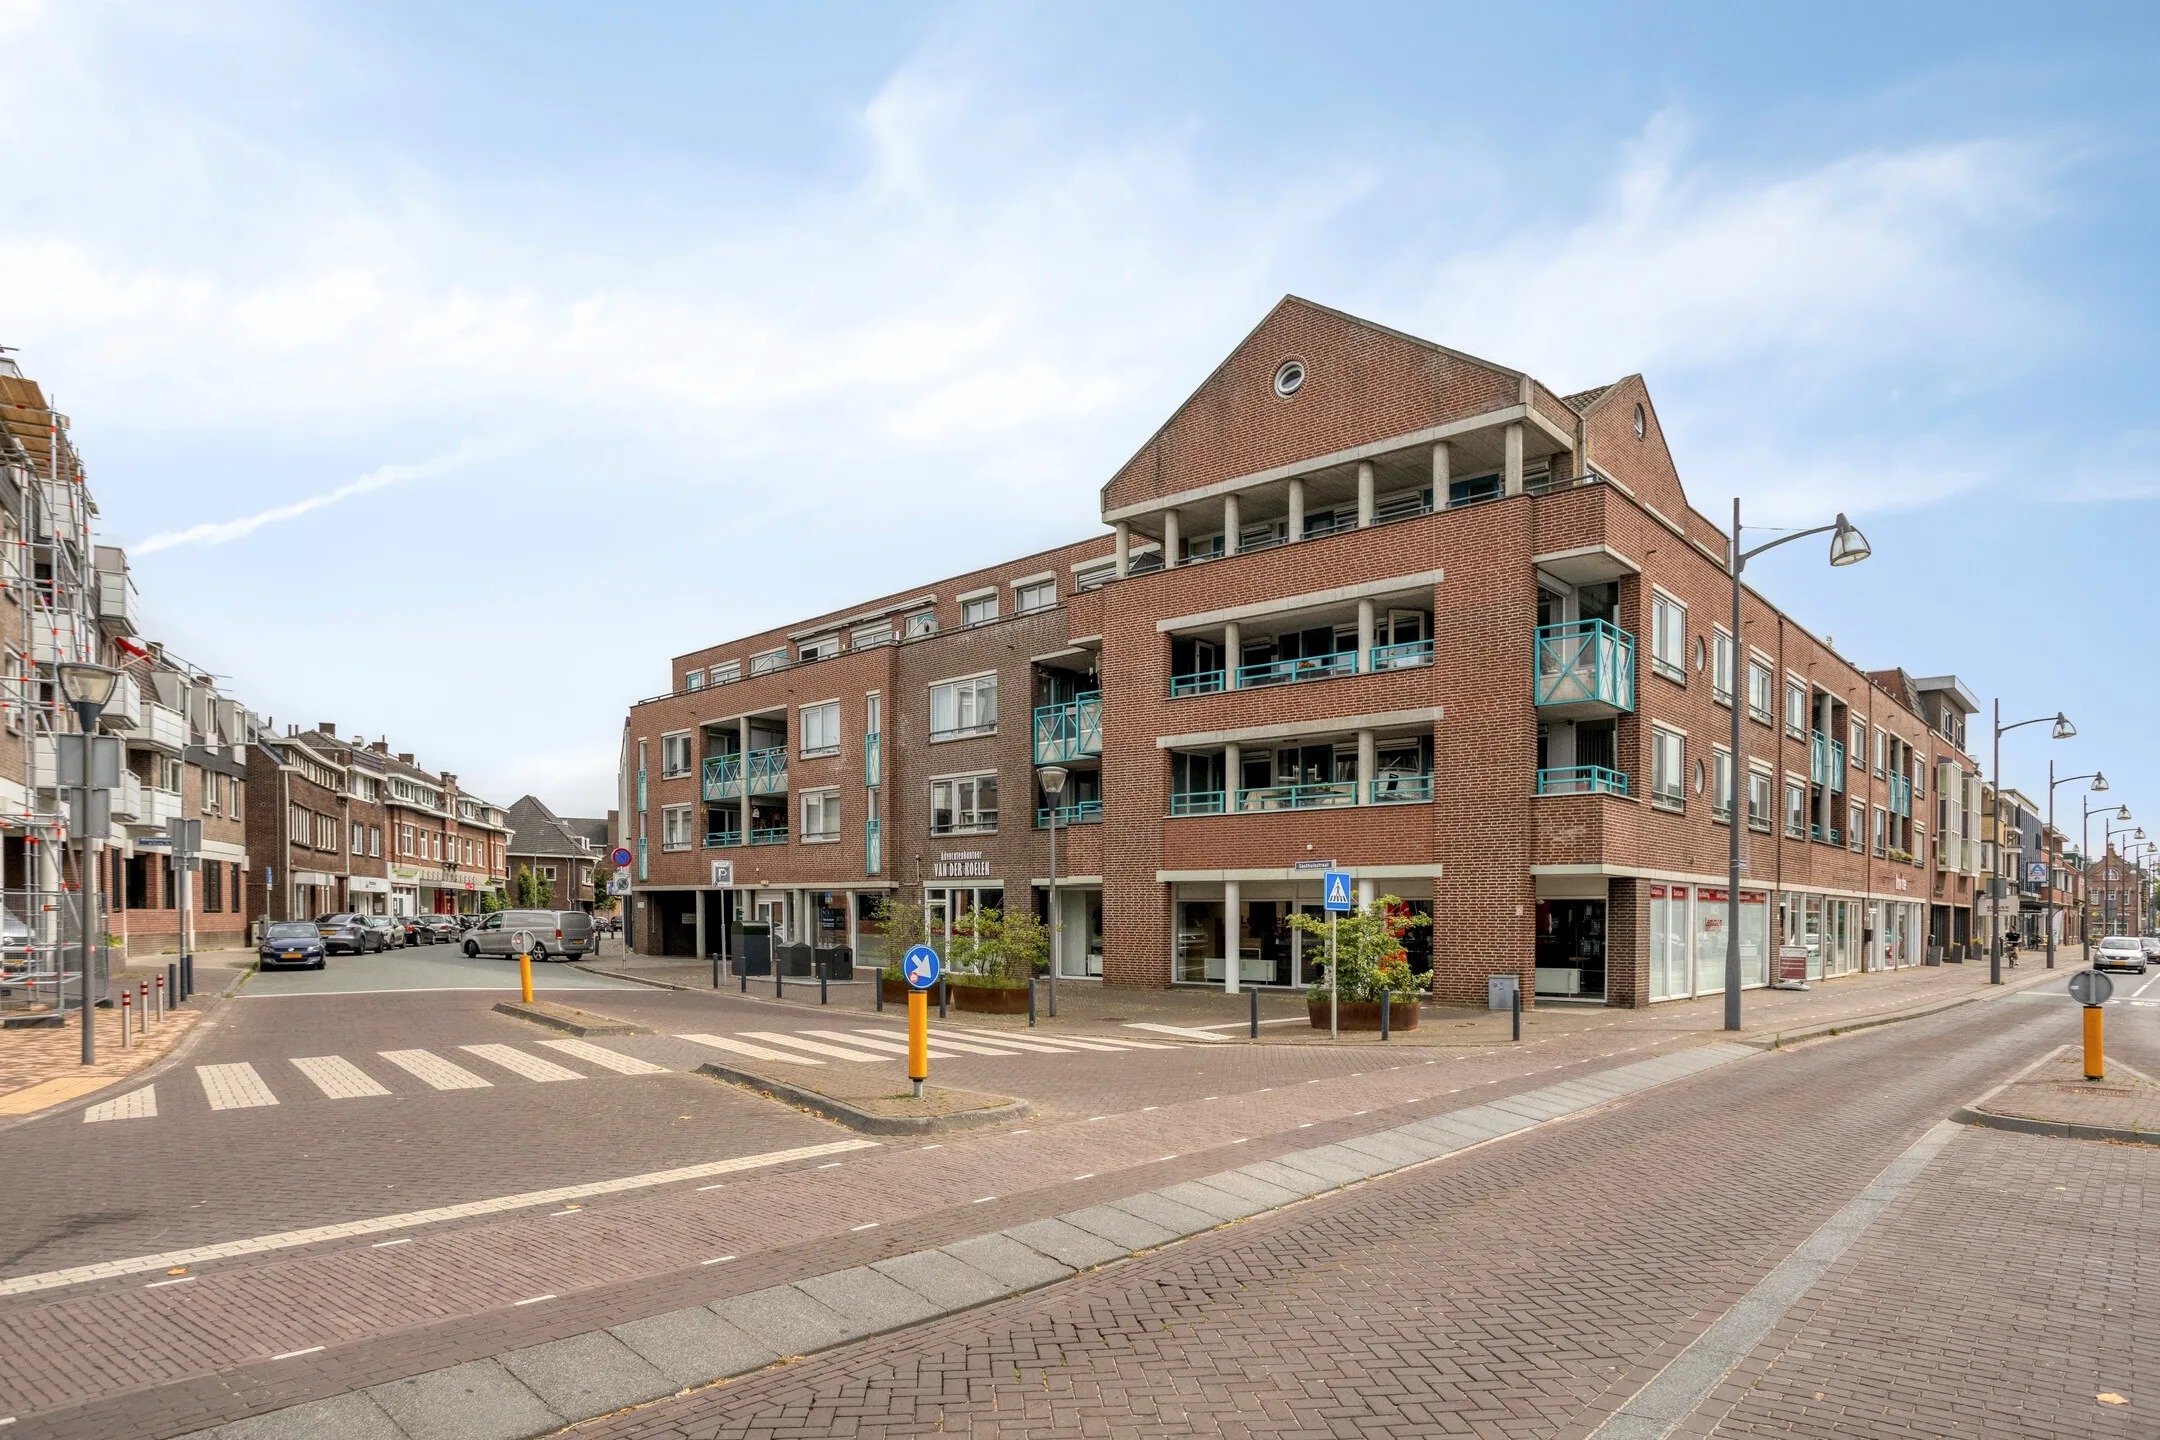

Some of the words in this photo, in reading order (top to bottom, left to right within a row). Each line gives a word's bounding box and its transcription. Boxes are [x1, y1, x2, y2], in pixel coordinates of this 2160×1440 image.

[941, 850, 982, 861] Advocatenkantoor
[934, 863, 947, 877] VAN
[949, 862, 963, 877] DER
[964, 861, 990, 876] KOELEN
